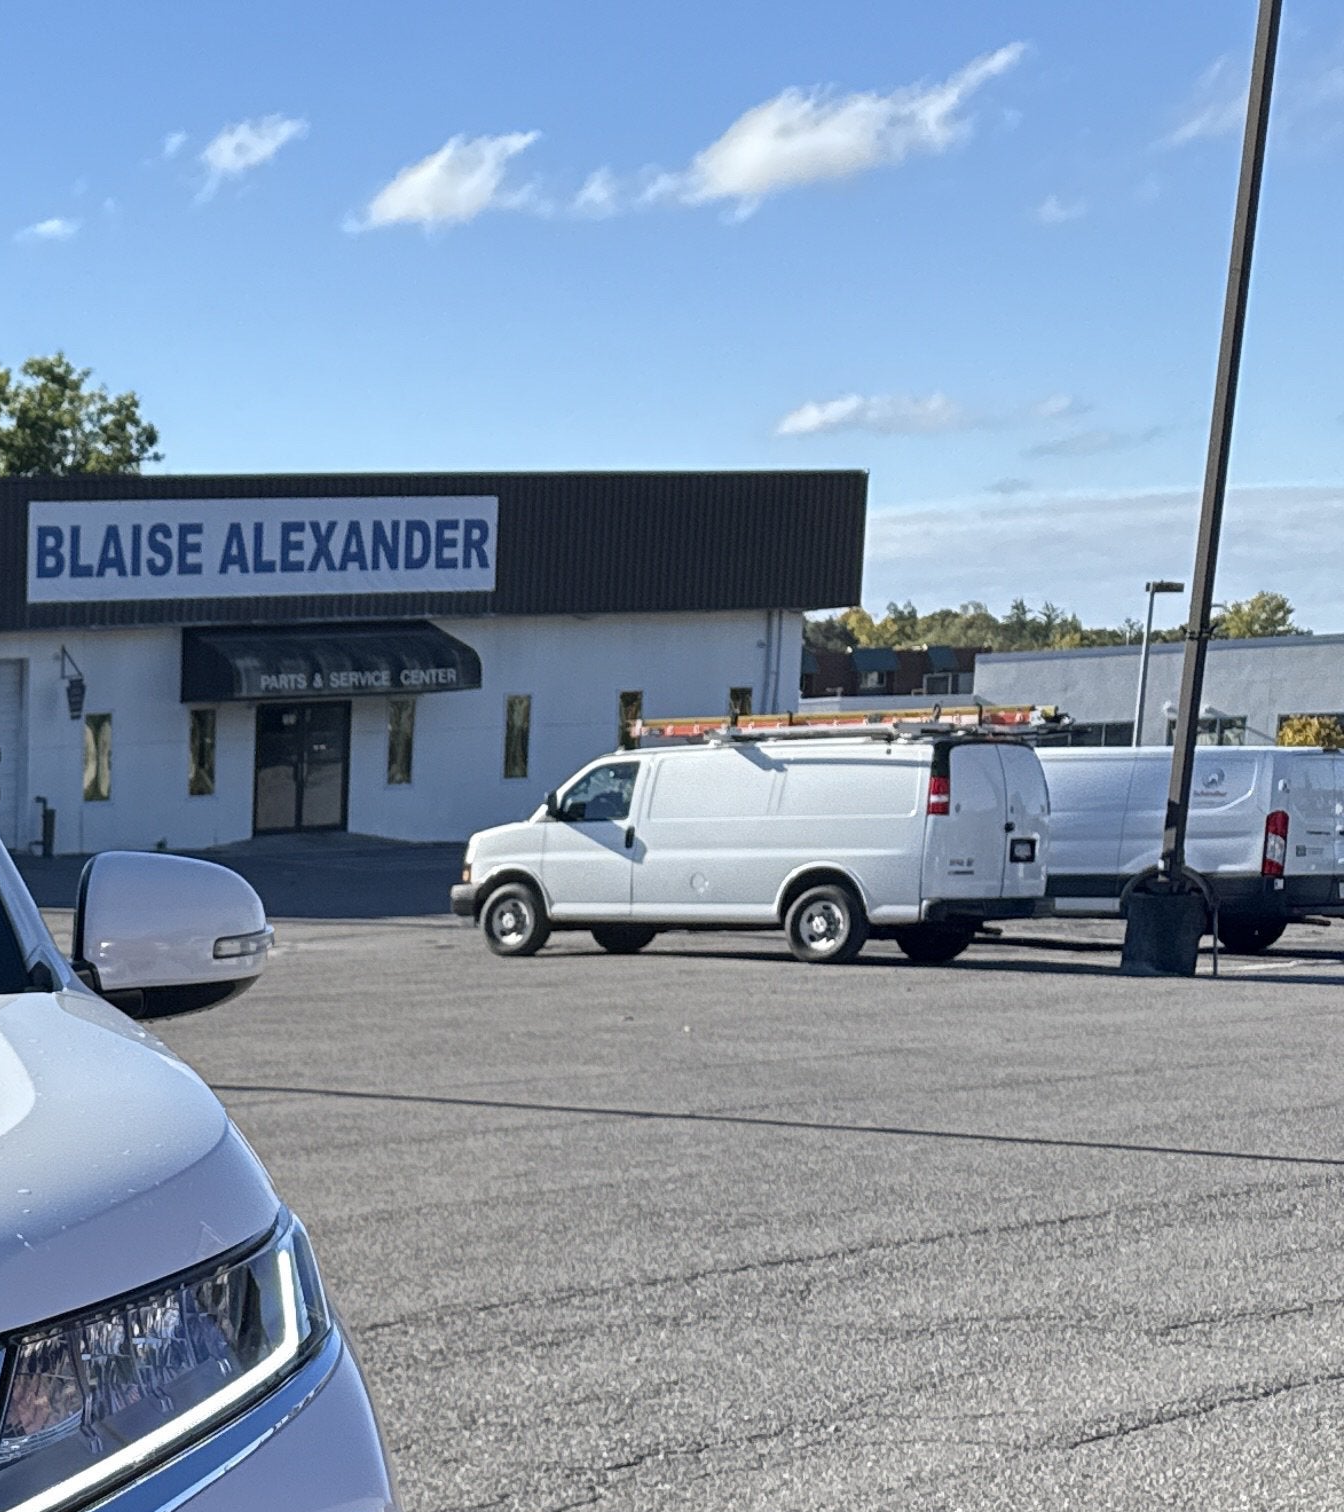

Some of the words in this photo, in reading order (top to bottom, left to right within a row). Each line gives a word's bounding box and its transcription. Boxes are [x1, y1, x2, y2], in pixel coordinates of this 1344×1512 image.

[36, 523, 203, 578] BLAISE
[219, 518, 490, 575] ALEXANDER
[260, 673, 308, 690] PARTS
[313, 674, 323, 688] &
[329, 670, 391, 688] SERVICE
[400, 668, 457, 685] CENTER
